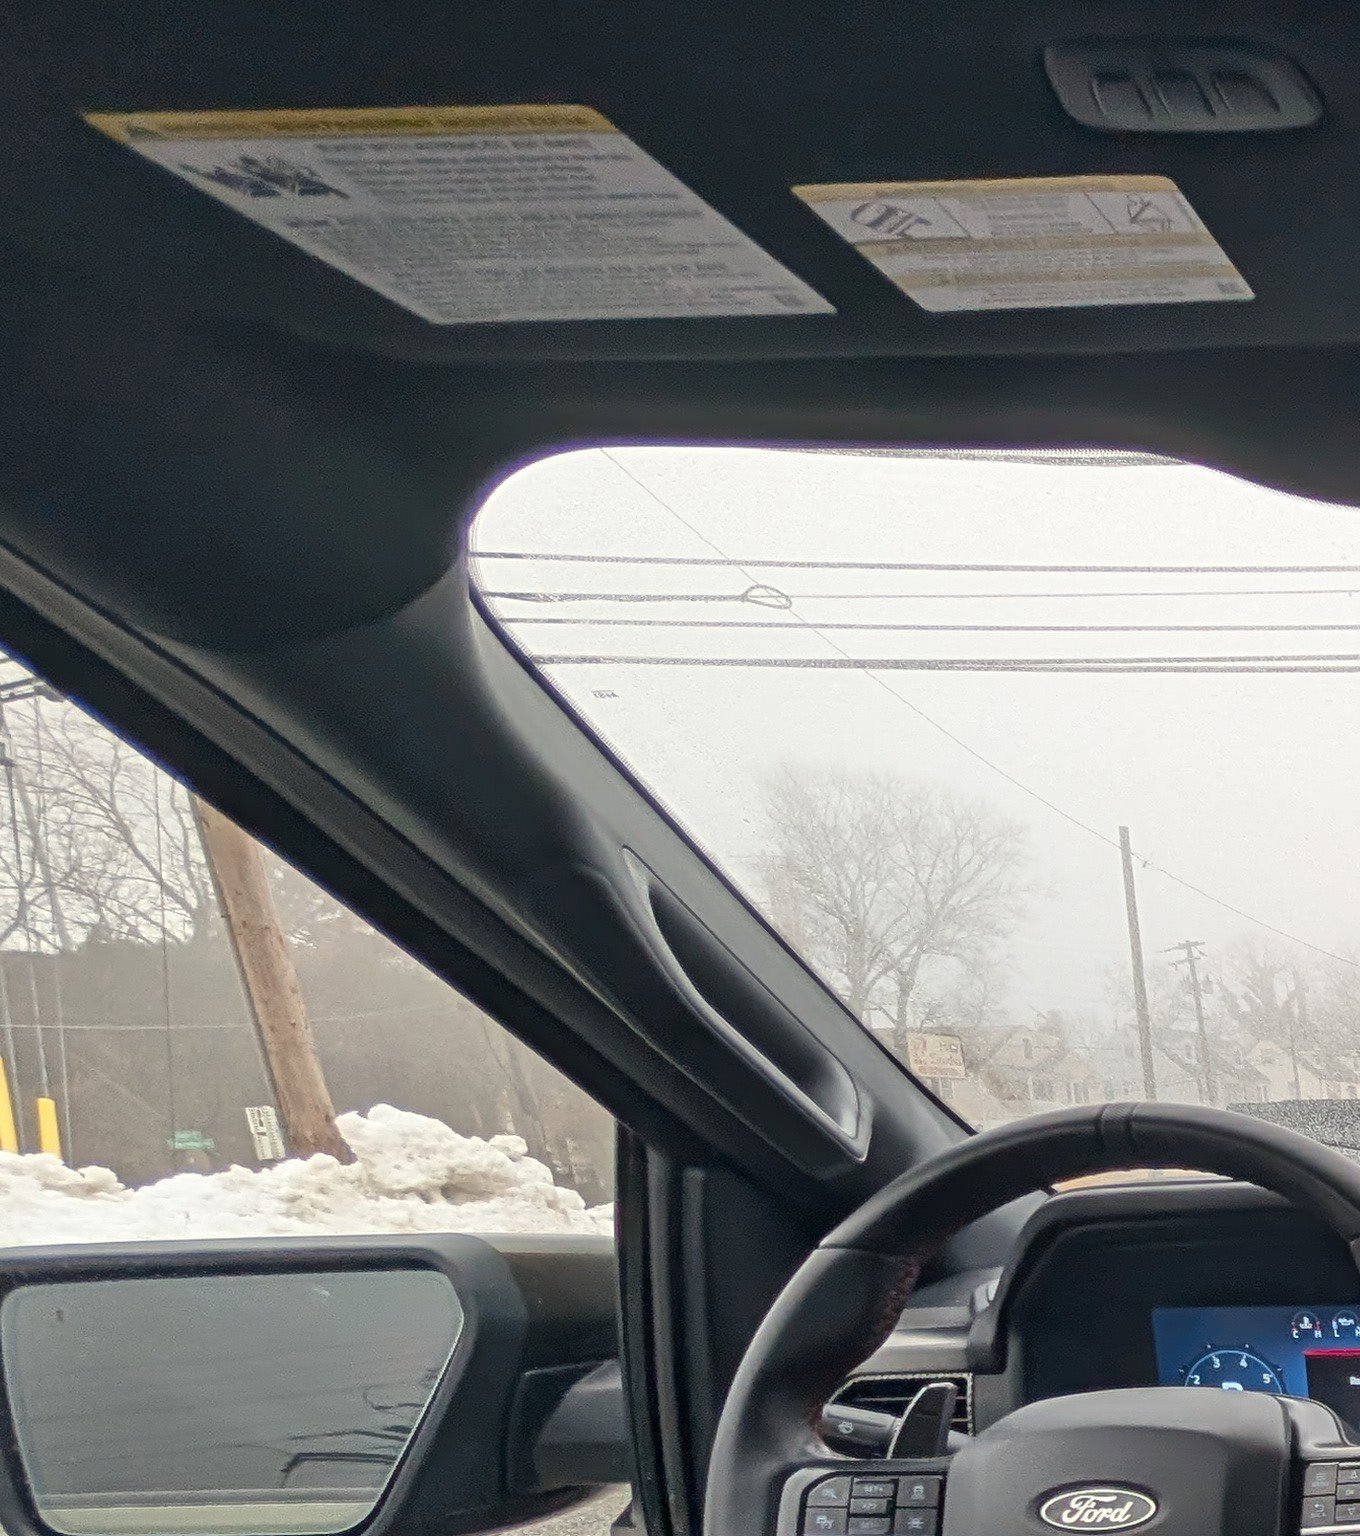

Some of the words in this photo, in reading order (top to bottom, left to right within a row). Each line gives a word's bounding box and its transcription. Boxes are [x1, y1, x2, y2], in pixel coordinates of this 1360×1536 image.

[1213, 1357, 1221, 1368] 3
[1240, 1357, 1248, 1368] 4
[1193, 1375, 1200, 1385] 2
[1262, 1374, 1271, 1384] 5
[1062, 1495, 1134, 1523] Ford
